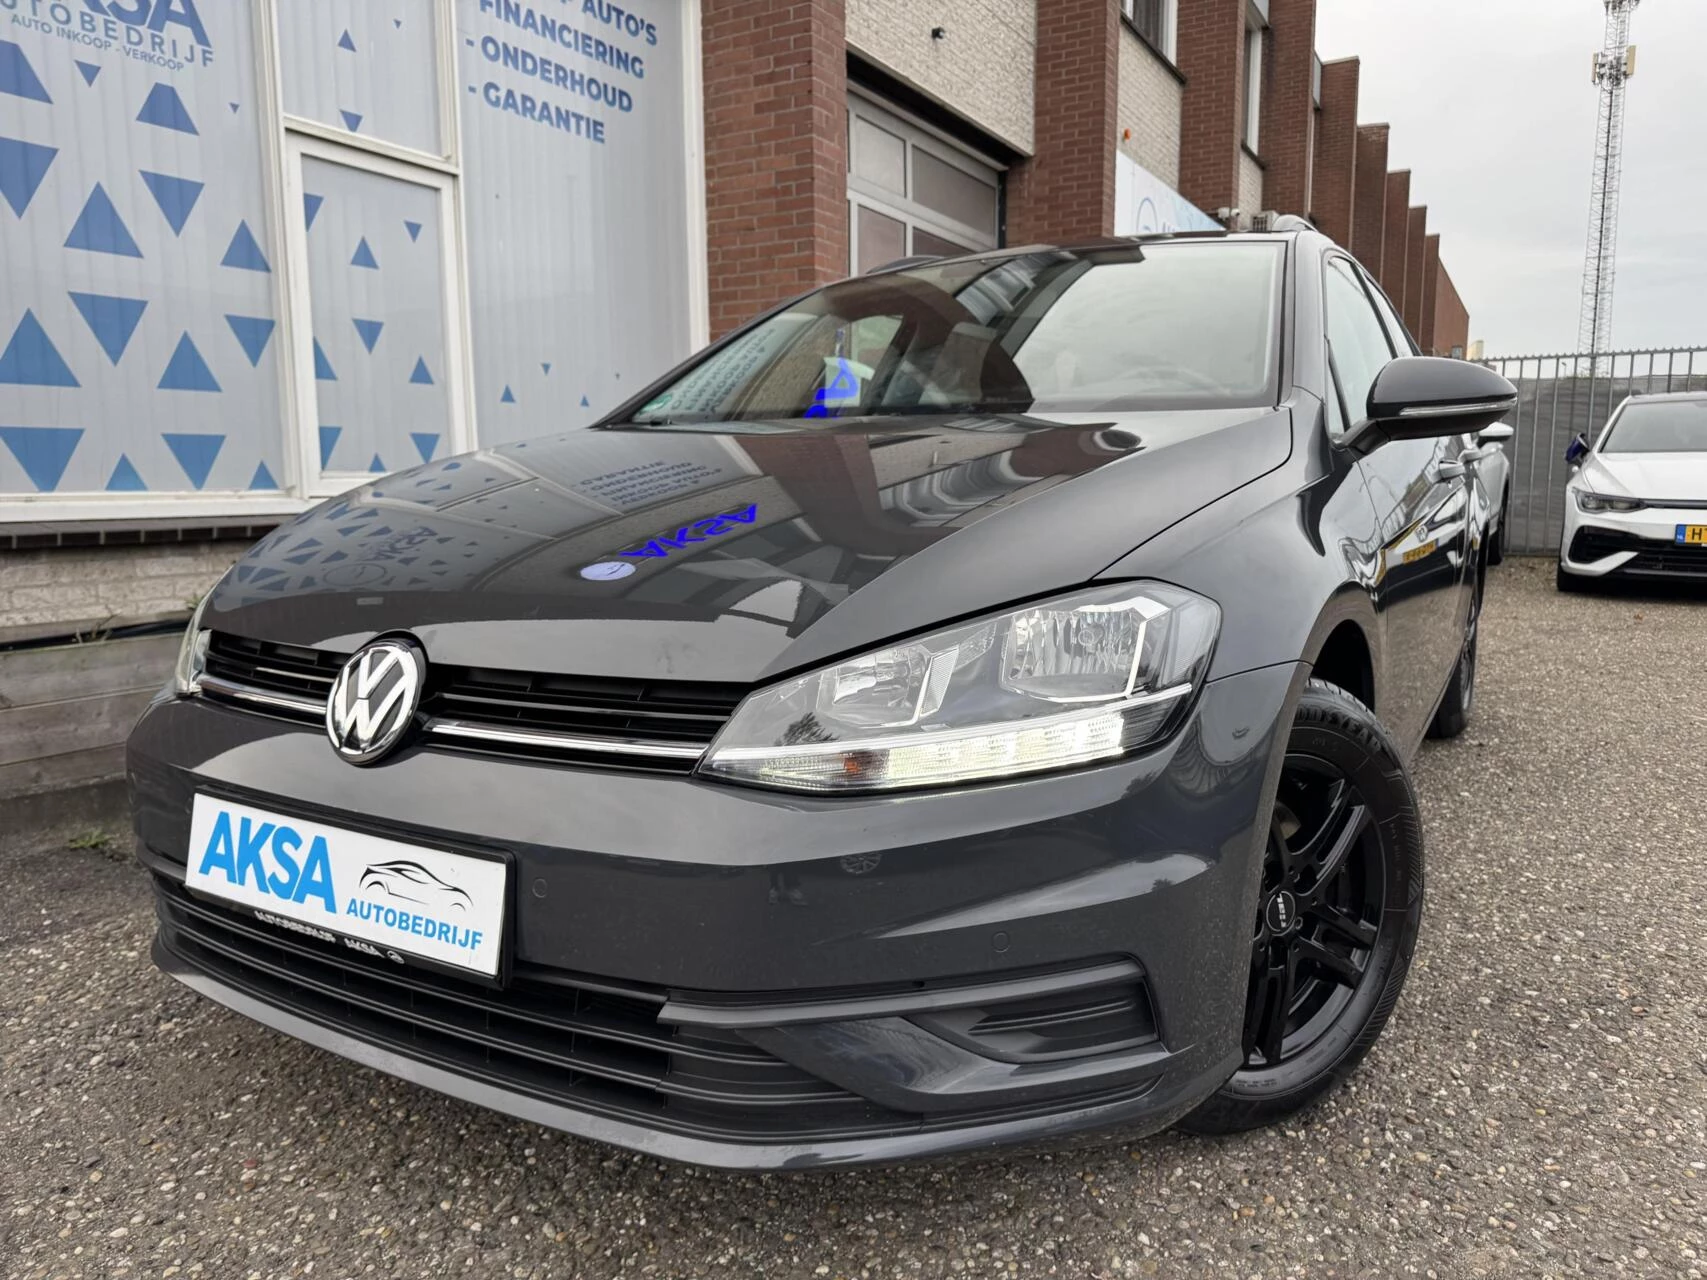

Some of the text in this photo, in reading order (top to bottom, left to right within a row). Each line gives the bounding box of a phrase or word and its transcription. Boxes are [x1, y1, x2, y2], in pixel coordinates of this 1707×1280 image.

[11, 14, 52, 34] AUTO
[57, 26, 112, 51] INKOOP
[123, 46, 184, 71] VERKOOP
[581, 0, 657, 46] AUTO'S
[481, 35, 633, 113] ONDERHOUD
[483, 81, 605, 144] GARANTIE
[198, 811, 338, 915] AKSA
[346, 897, 484, 951] AUTOBEDRIJF
